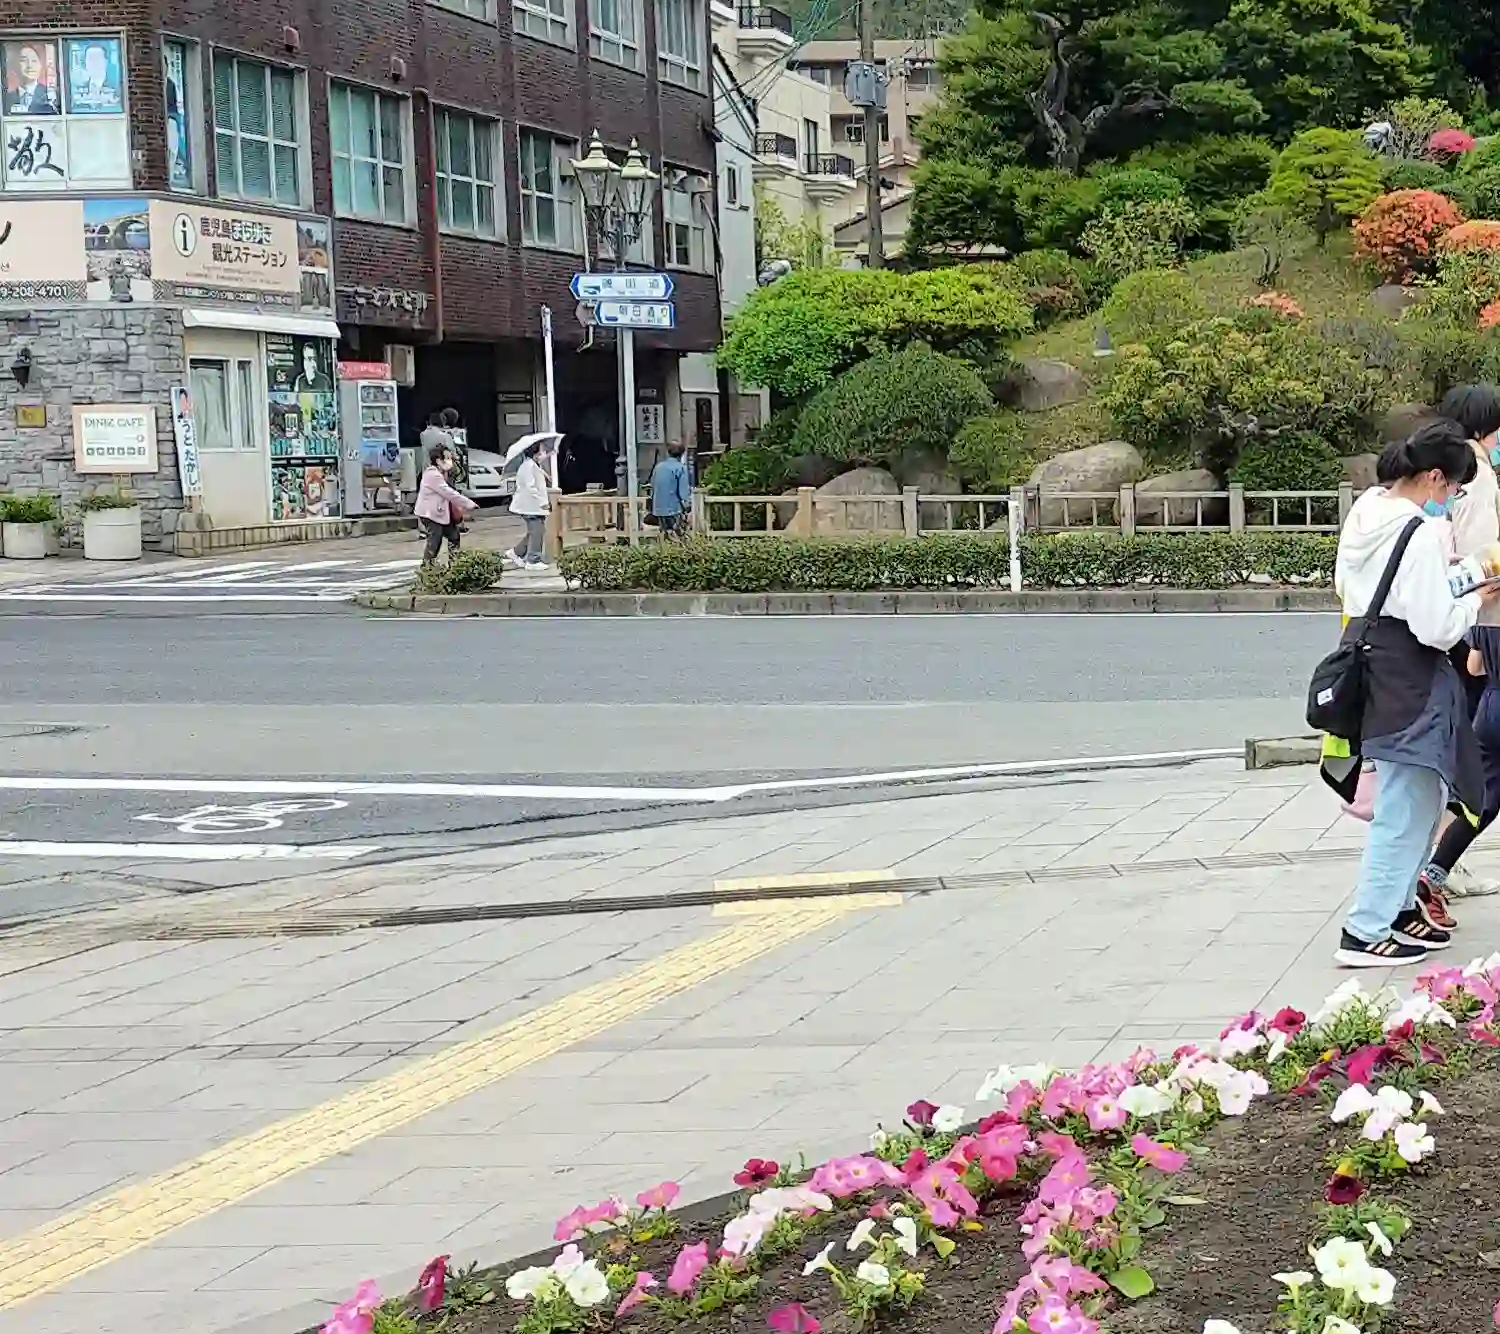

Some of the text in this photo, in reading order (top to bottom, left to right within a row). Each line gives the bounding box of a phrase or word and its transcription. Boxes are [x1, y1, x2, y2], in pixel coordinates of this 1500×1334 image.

[212, 242, 288, 267] 観光ステーション
[117, 417, 146, 428] CAFE
[181, 419, 200, 486] うとたかし
